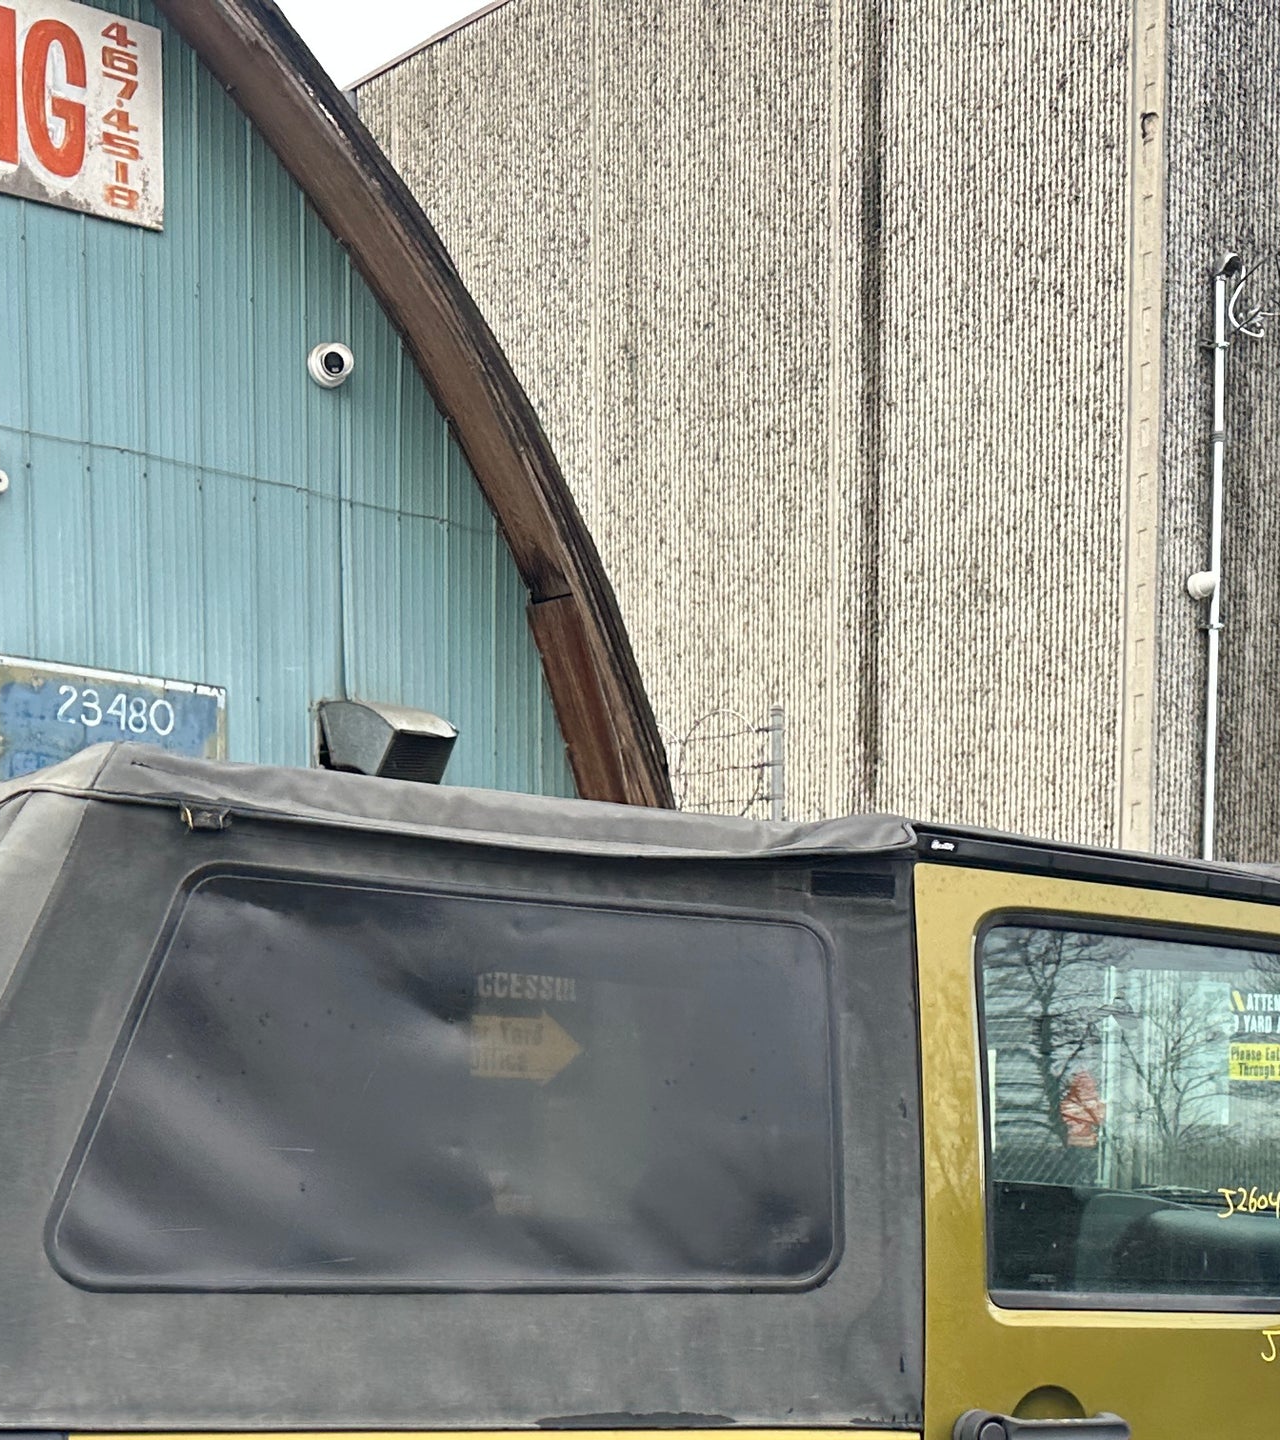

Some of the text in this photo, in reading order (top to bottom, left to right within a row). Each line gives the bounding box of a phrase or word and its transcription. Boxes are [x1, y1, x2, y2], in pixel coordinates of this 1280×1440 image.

[56, 684, 175, 736] 23480
[1244, 1016, 1272, 1033] YARD
[1231, 1047, 1262, 1062] Please
[1238, 1062, 1276, 1079] Through
